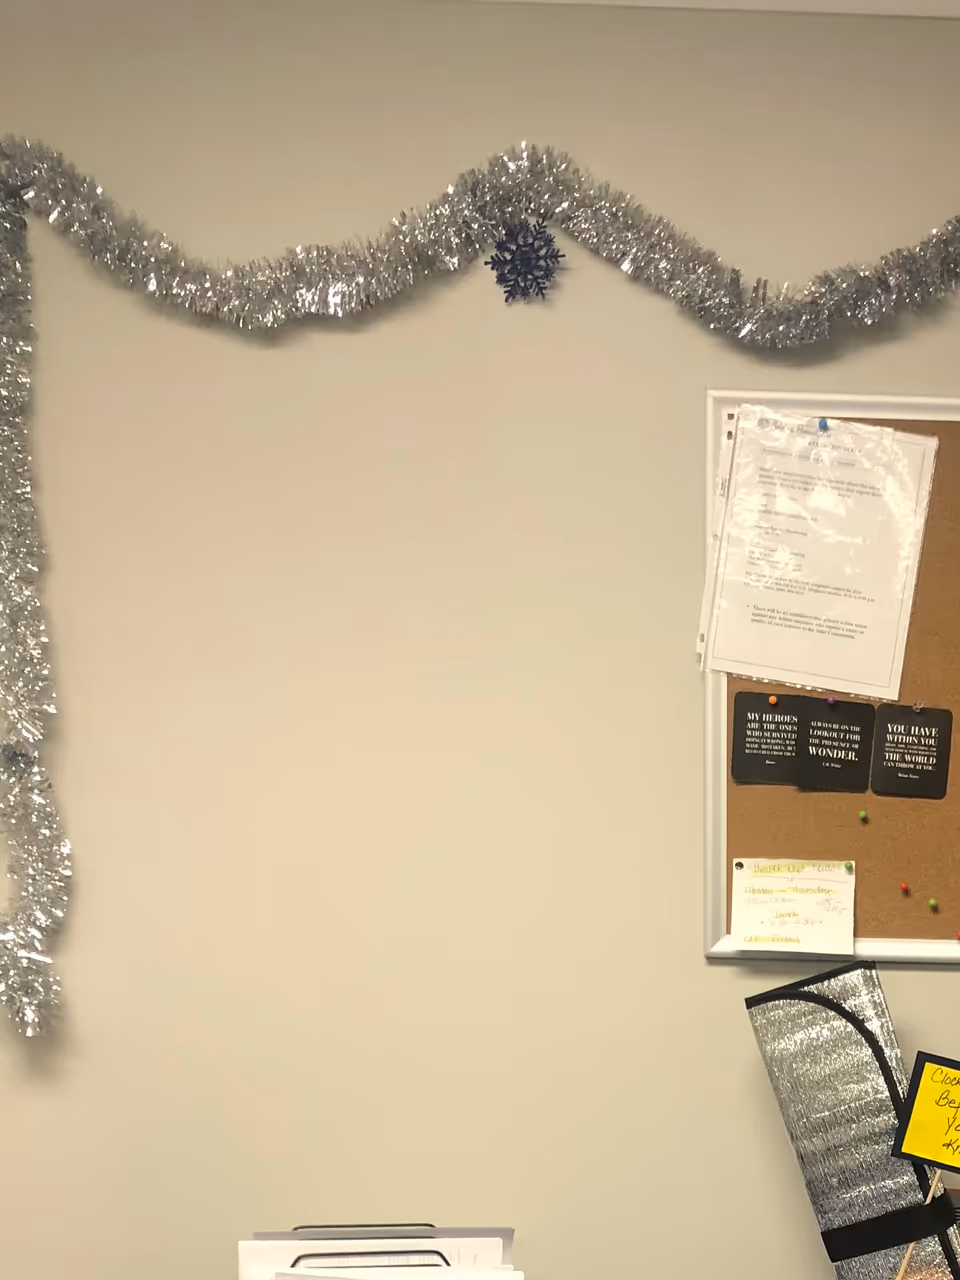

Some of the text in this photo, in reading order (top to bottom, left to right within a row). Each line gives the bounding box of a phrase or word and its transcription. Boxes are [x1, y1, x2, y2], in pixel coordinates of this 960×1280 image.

[746, 711, 798, 724] MY HEROES
[746, 722, 798, 732] ARE THE ONES
[888, 724, 938, 737] YOU HAVE
[746, 730, 762, 738] WHO
[809, 728, 861, 742] LOOKOUT FOR
[886, 734, 938, 746] WITHIN YOU
[808, 746, 858, 761] WONDER.
[884, 752, 936, 764] THE WORLD
